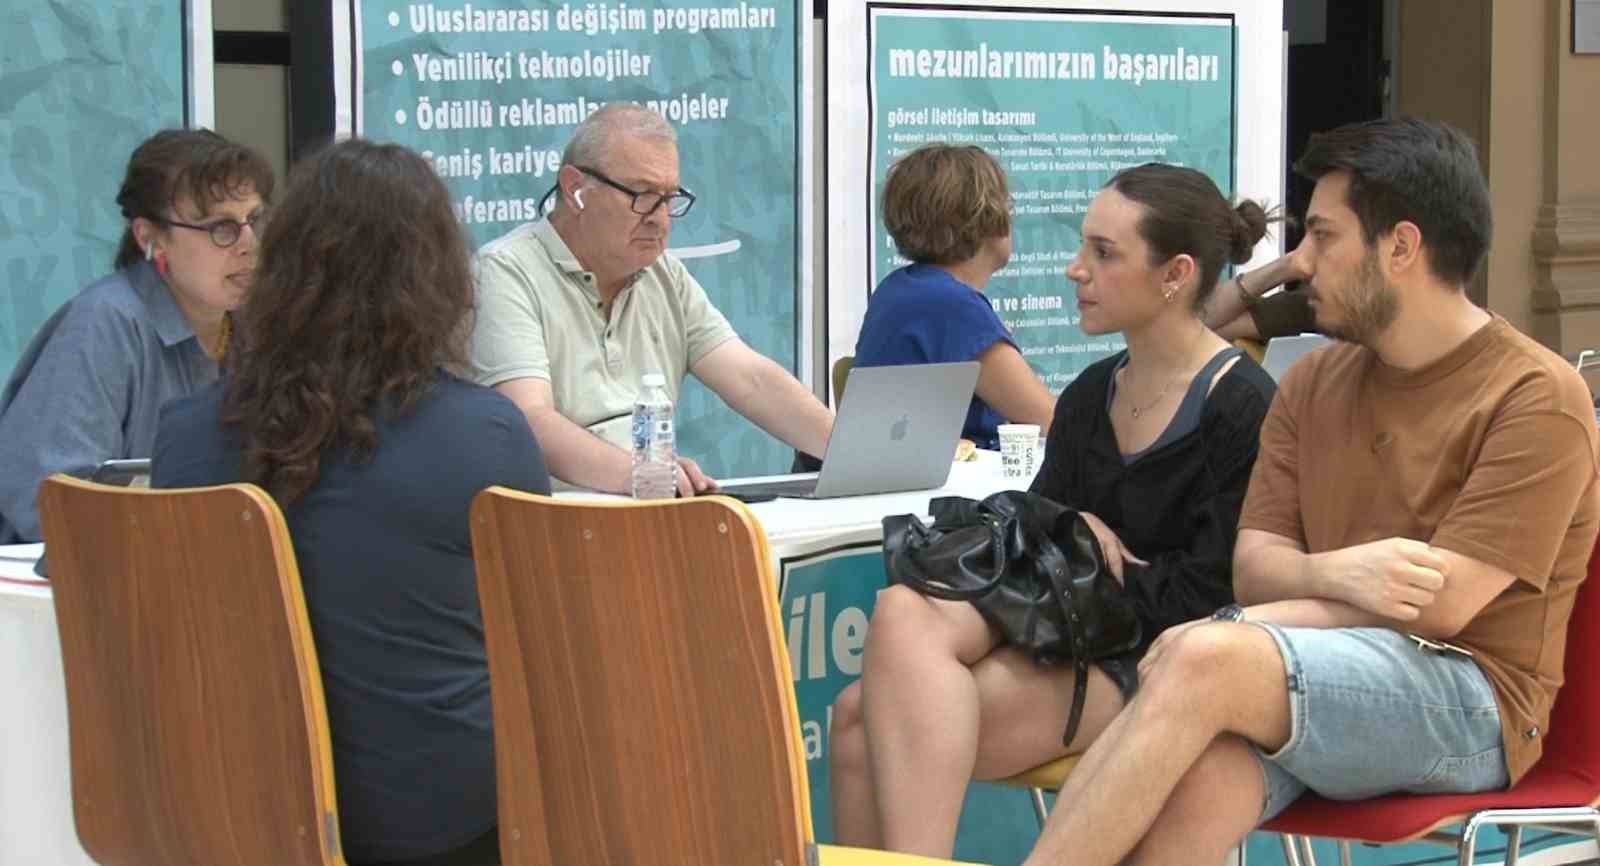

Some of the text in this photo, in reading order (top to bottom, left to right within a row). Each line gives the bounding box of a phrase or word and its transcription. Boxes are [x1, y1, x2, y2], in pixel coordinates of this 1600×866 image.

[409, 2, 776, 35] Uluslararası değişim programları
[413, 49, 652, 83] Yenilikçi teknolojiler
[889, 42, 1218, 86] mezunlarımızın başarıları
[416, 96, 493, 130] Ödüllü
[888, 107, 1036, 129] görsel iletişim tasarımı
[490, 146, 562, 177] kariye
[1004, 298, 1018, 311] ve
[1021, 294, 1063, 310] sinema
[788, 592, 869, 681] ile
